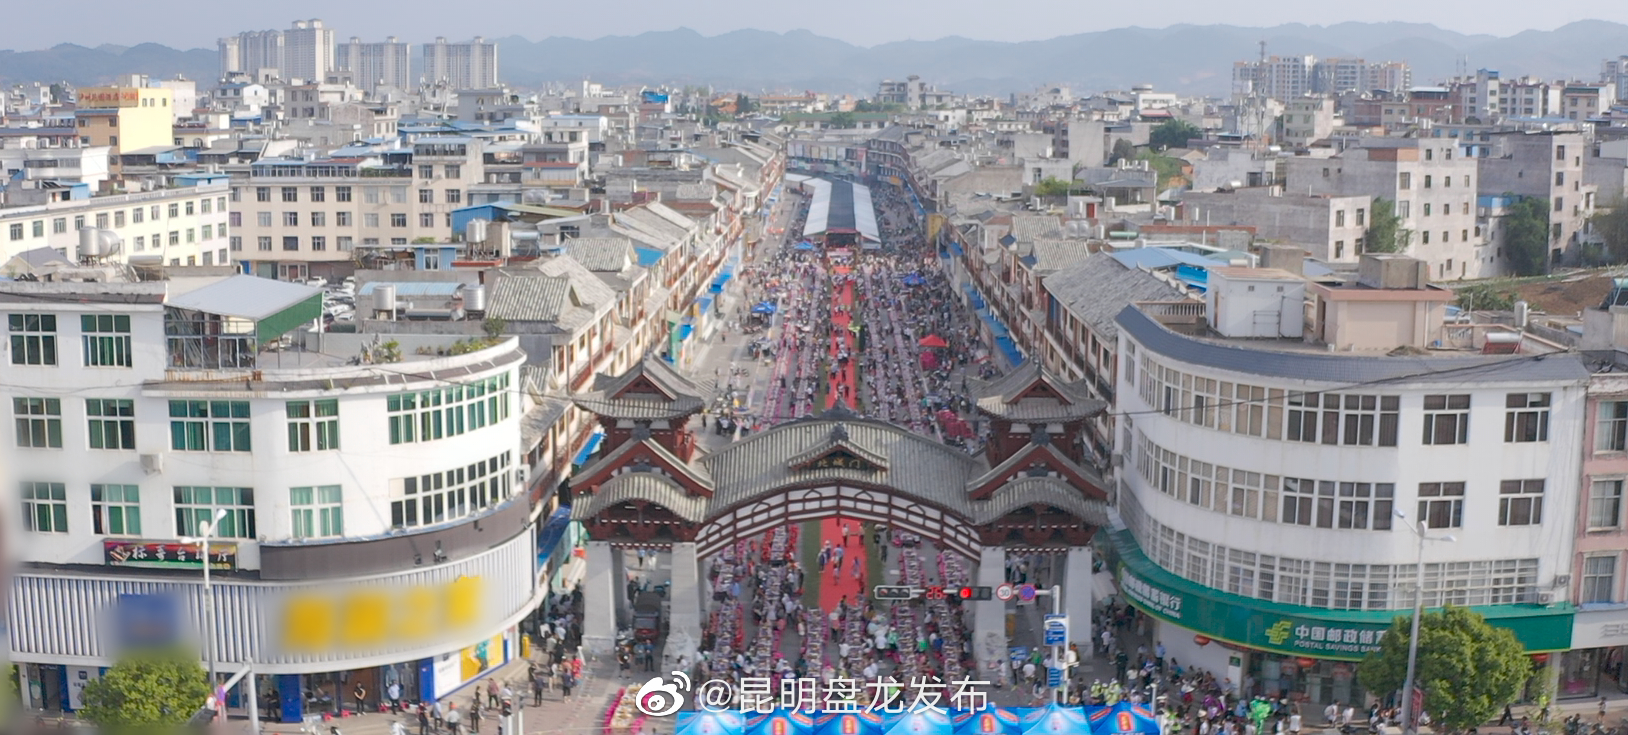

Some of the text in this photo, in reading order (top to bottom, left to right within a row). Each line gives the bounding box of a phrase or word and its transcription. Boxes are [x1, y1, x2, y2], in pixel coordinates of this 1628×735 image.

[1000, 588, 1010, 597] 30
[1295, 640, 1323, 649] POSTAL
[1325, 643, 1359, 652] SAVINGS
